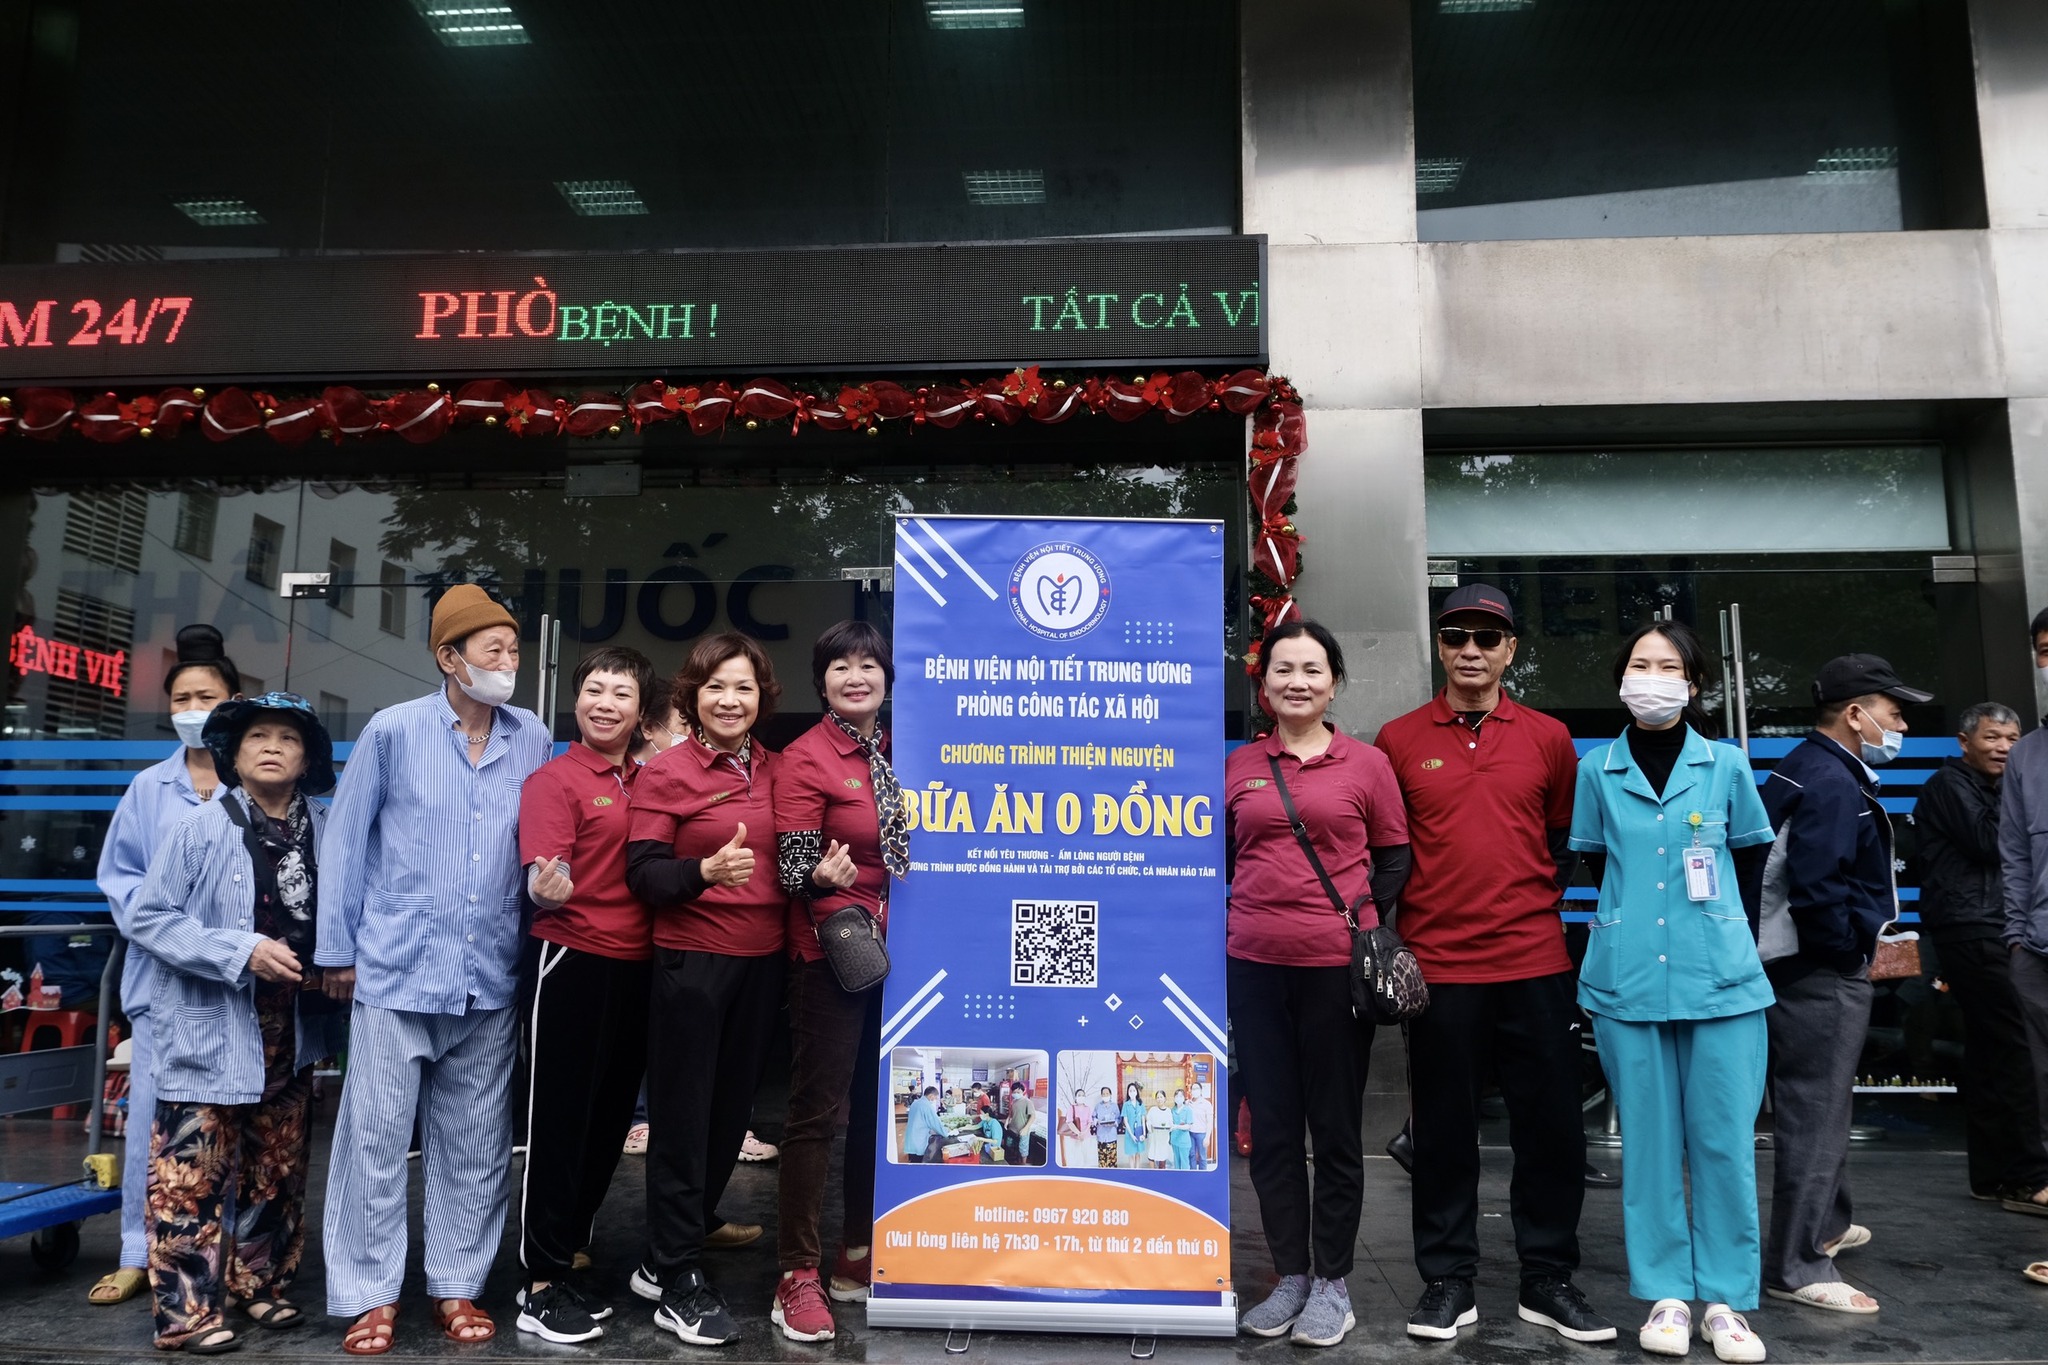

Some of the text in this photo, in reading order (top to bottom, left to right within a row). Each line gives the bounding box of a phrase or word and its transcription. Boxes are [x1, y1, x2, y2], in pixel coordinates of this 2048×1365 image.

[67, 297, 193, 346] 24/7
[415, 275, 556, 338] PHÒ
[557, 301, 696, 347] BỆNH
[1022, 286, 1119, 331] TẤT
[1132, 283, 1201, 328] CẢ
[1013, 563, 1026, 582] BỆNH
[1024, 550, 1040, 564] VIỆN
[1040, 545, 1054, 554] NỘI
[1054, 543, 1071, 552] TIẾT
[1072, 547, 1095, 564] TRUNG
[1011, 597, 1108, 639] NATIONAL HOSPITAL OF ENDOCRINOLOGY
[925, 653, 1192, 684] BỆNH VIỆN NỘI TIẾT TRUNG ƯƠNG
[957, 690, 1159, 723] PHÒNG CÔNG TÁC XÃ HỘI
[940, 741, 1175, 772] CHƯƠNG TRÌNH THIỆN NGUYỆN
[904, 780, 1213, 837] BỮA ĂN 0 ĐỒNG
[908, 861, 929, 872] ƯƠNG
[930, 861, 954, 872] TRÌNH
[955, 862, 978, 874] ĐƯỢC
[1003, 862, 1026, 874] HÀNH
[1027, 862, 1038, 874] VÀ
[1039, 862, 1053, 874] TÀI
[1054, 864, 1070, 876] TRỢ
[1071, 863, 1086, 875] BỞI
[1087, 863, 1104, 875] CÁC
[1117, 864, 1141, 877] CHỨC,
[1143, 865, 1155, 876] CÁ
[1156, 865, 1179, 877] NHÂN
[1180, 864, 1197, 877] HẢO
[1198, 866, 1216, 877] TÂM
[967, 847, 983, 859] KẾT
[984, 847, 998, 859] NỐI
[1000, 848, 1016, 860] YÊU
[1017, 849, 1049, 860] THƯƠNG
[1058, 848, 1072, 860] ẤM
[1073, 849, 1095, 861] LÒNG
[1096, 849, 1122, 862] NGƯỜI
[1123, 850, 1145, 864] BỆNH
[974, 1205, 1129, 1226] Hotline: 0967 920 880
[885, 1230, 912, 1249] (Vui
[916, 1231, 948, 1250] lòng
[952, 1231, 979, 1250] liên
[982, 1232, 1000, 1253] hệ
[1004, 1233, 1040, 1252] 7h30
[1053, 1235, 1085, 1255] 17h,
[1088, 1235, 1104, 1253] từ
[1106, 1236, 1130, 1254] thứ
[1132, 1237, 1143, 1254] 2
[1146, 1235, 1173, 1255] đến
[1176, 1237, 1201, 1256] thứ
[1203, 1239, 1219, 1259] 6)
